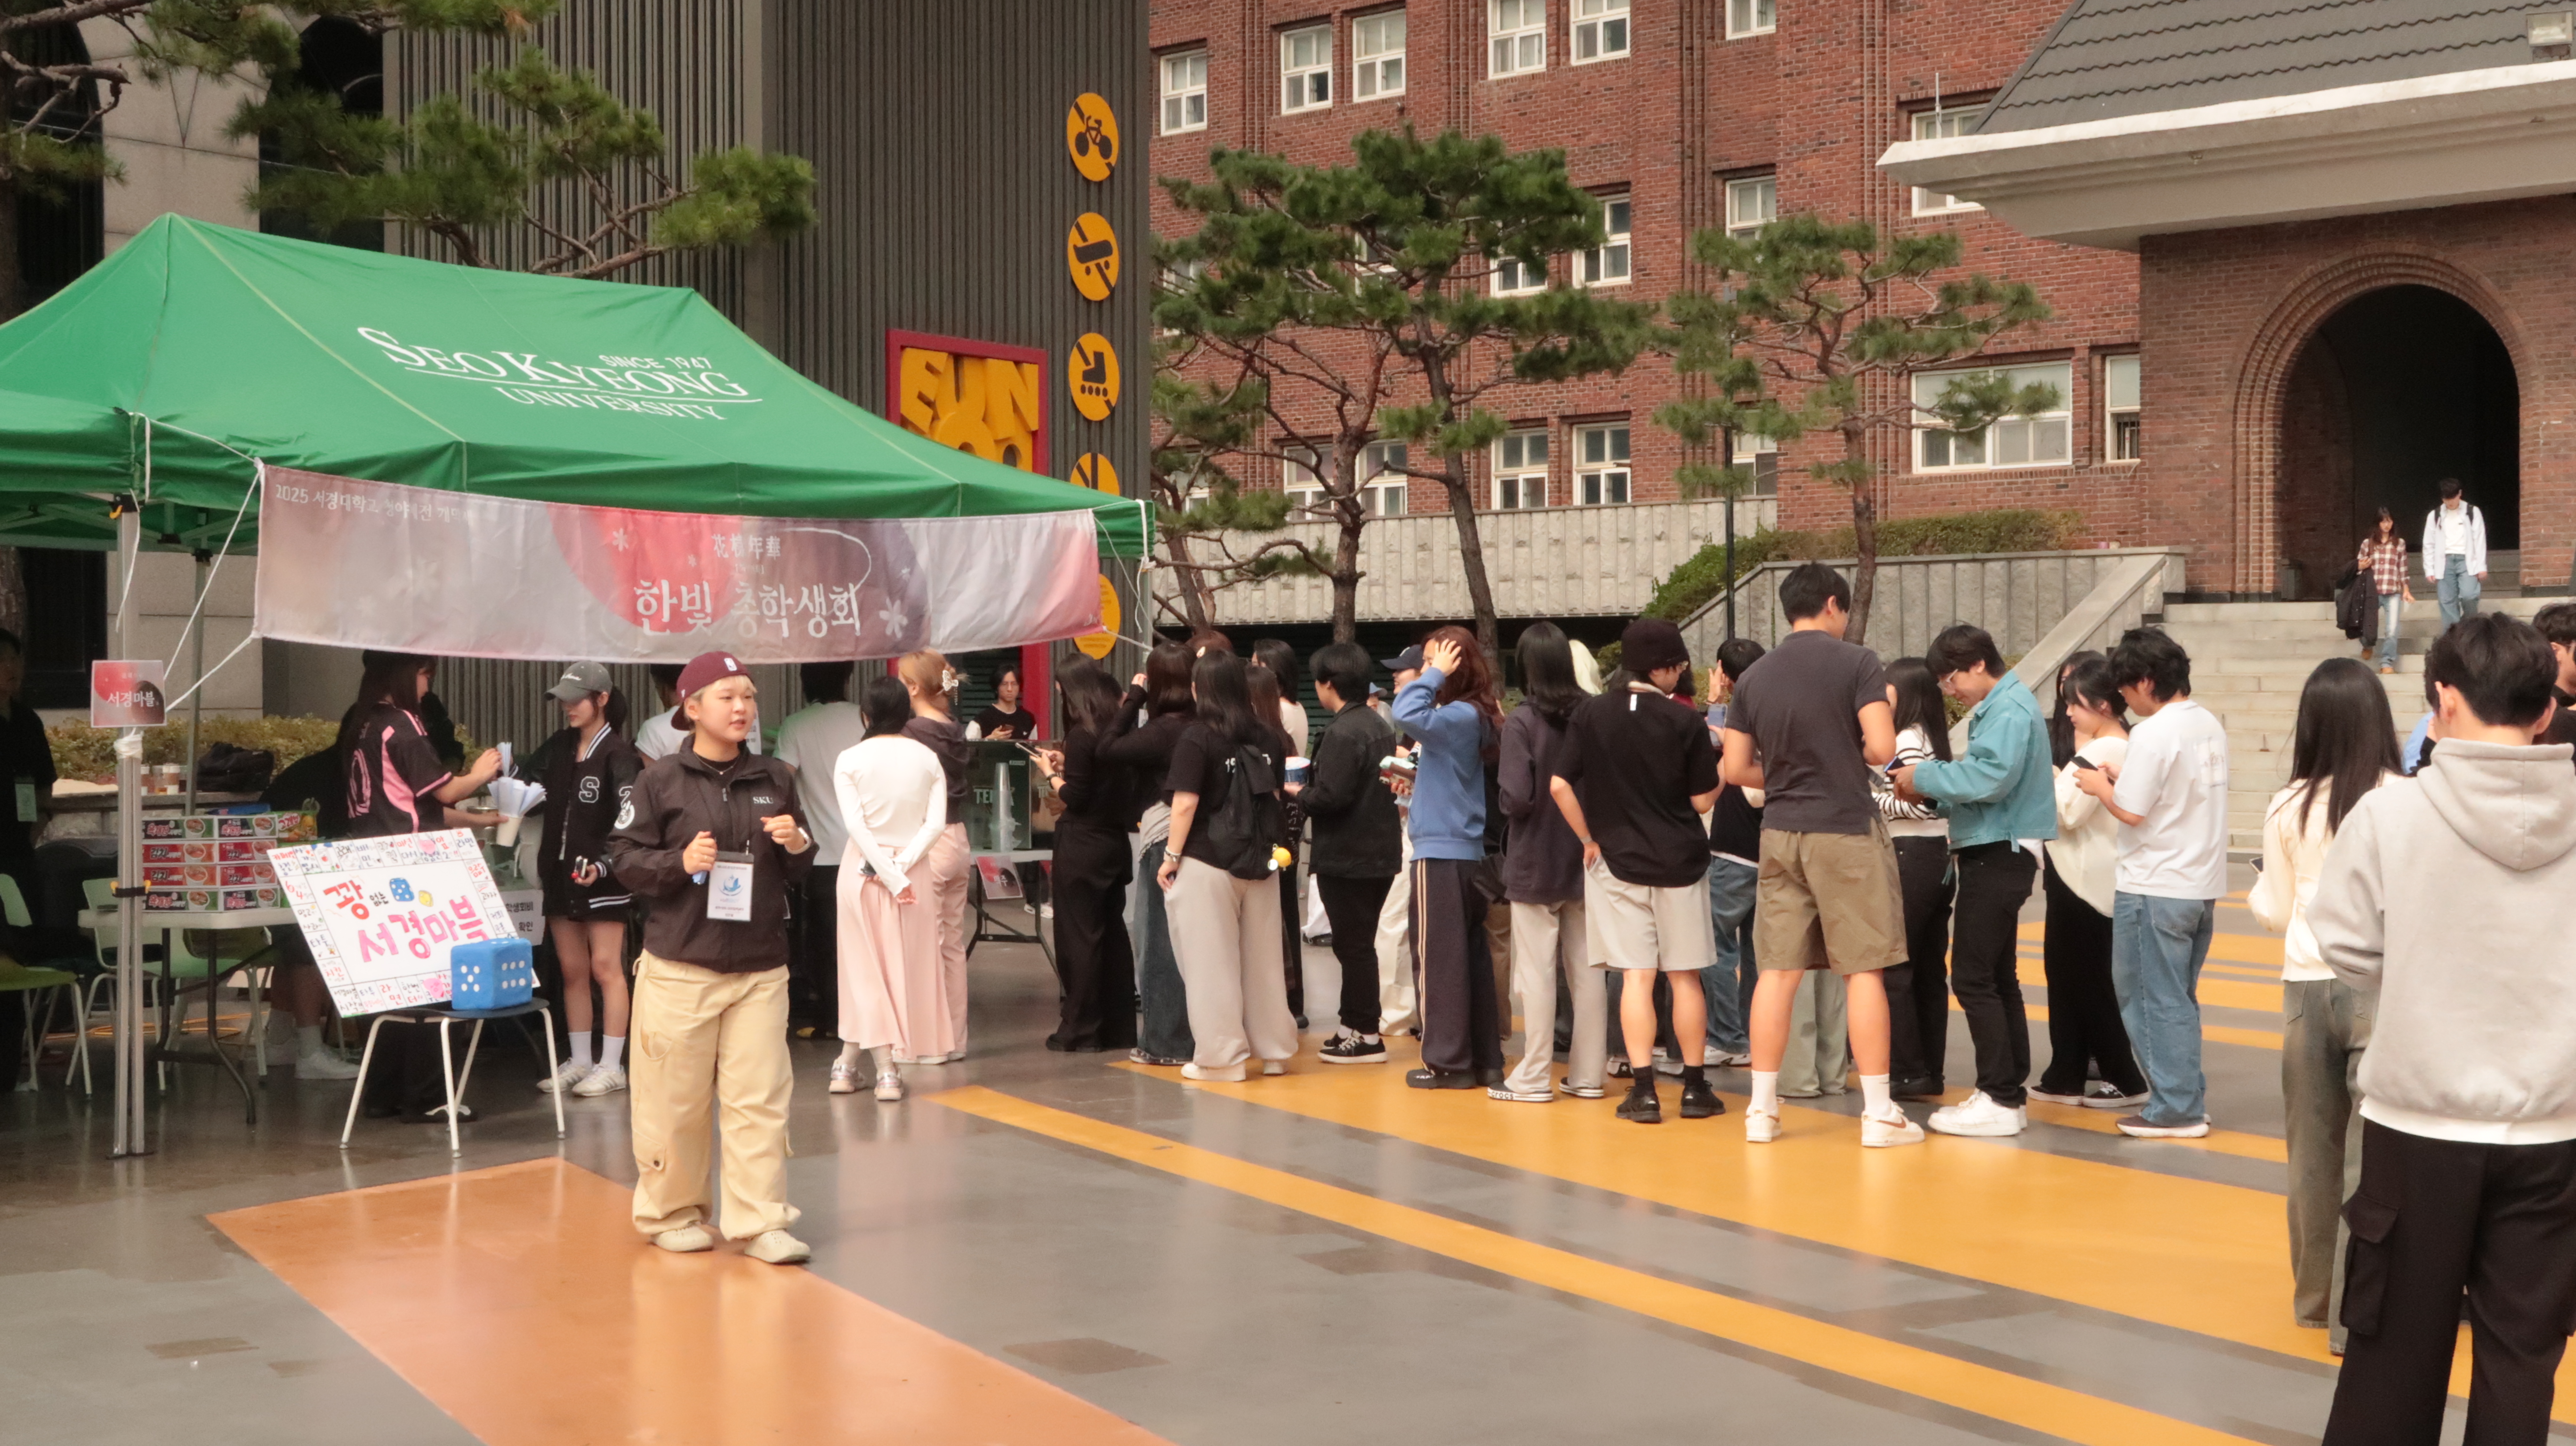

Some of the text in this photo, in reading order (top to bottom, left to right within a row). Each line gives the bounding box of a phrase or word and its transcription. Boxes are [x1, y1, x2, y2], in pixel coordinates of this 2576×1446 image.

[598, 354, 713, 370] SINCE 1947
[492, 386, 728, 420] UNIVERSITY
[275, 484, 309, 504] 2025
[312, 490, 378, 513] 서경대학교
[634, 579, 861, 638] 한빛 총학생회
[107, 691, 155, 707] 서경마블
[579, 776, 600, 803] S
[753, 796, 773, 804] SKU
[323, 879, 389, 920] 꽝 없는
[358, 895, 490, 963] 서경마블
[519, 921, 533, 932] 확인
[1491, 1091, 1514, 1100] crocs
